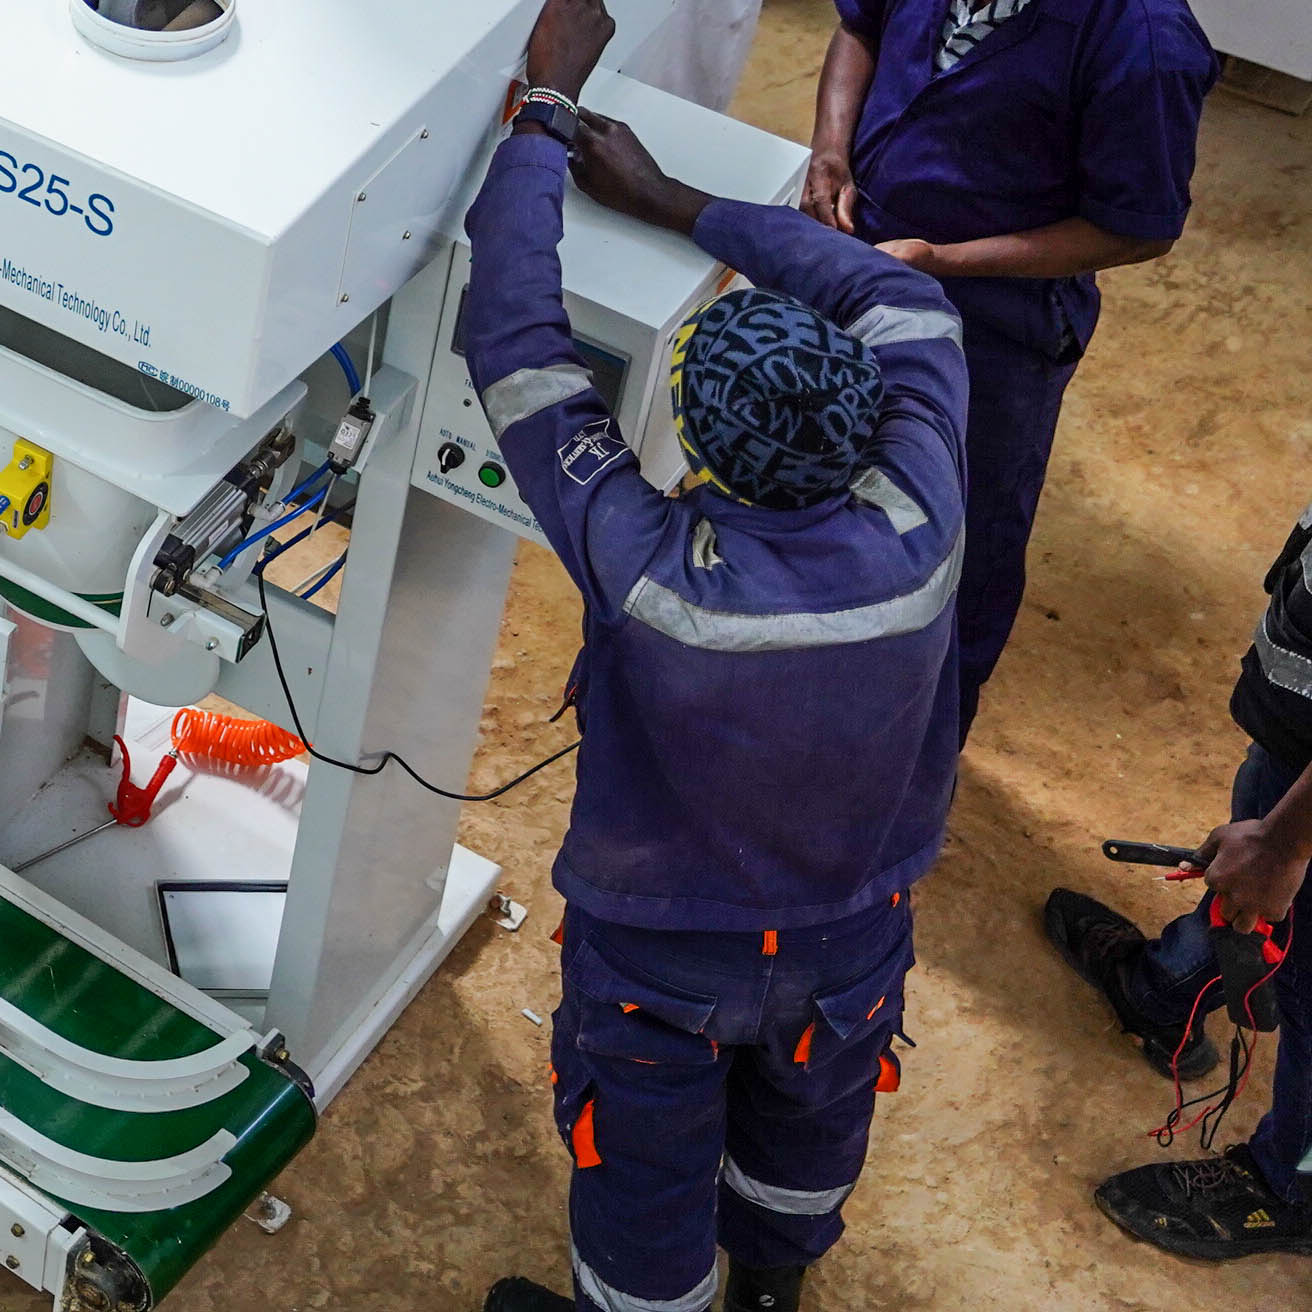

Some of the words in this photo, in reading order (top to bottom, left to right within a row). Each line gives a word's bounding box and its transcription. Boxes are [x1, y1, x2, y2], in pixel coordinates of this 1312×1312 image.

[56, 284, 111, 334] Technology
[112, 310, 132, 341] Co.,
[133, 320, 153, 348] Ltd.
[444, 479, 476, 504] Yongcheng
